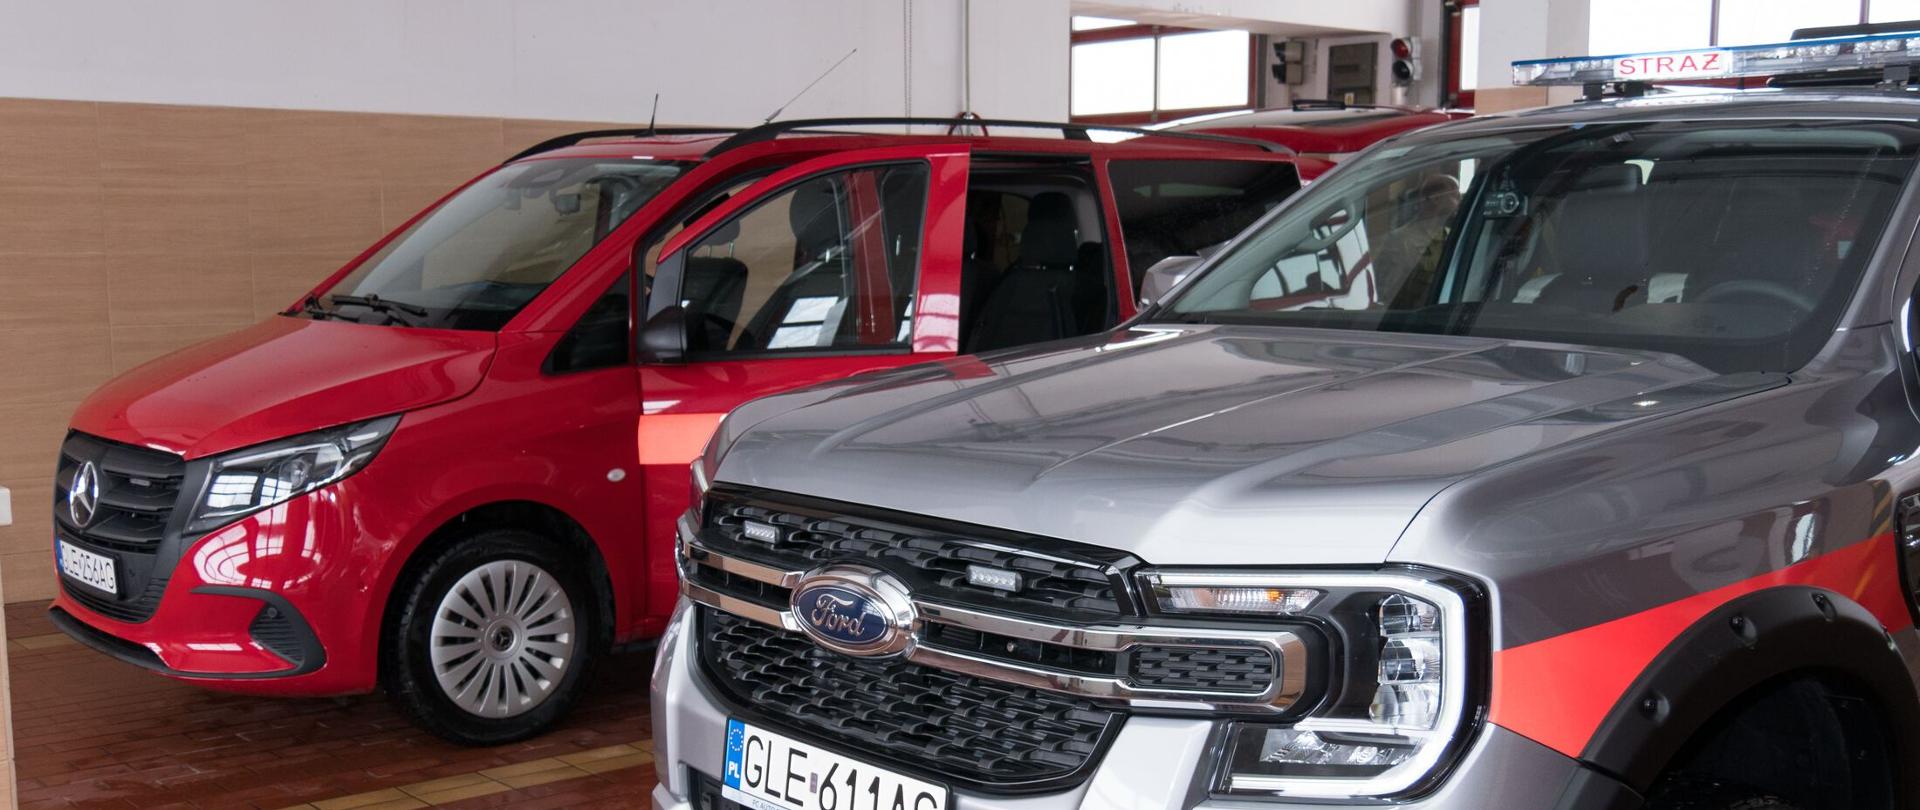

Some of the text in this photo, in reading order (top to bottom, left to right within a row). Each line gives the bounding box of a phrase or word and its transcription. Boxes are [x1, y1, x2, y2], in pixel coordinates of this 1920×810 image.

[811, 593, 866, 637] Ford
[728, 760, 740, 779] PL
[744, 735, 808, 807] GLE
